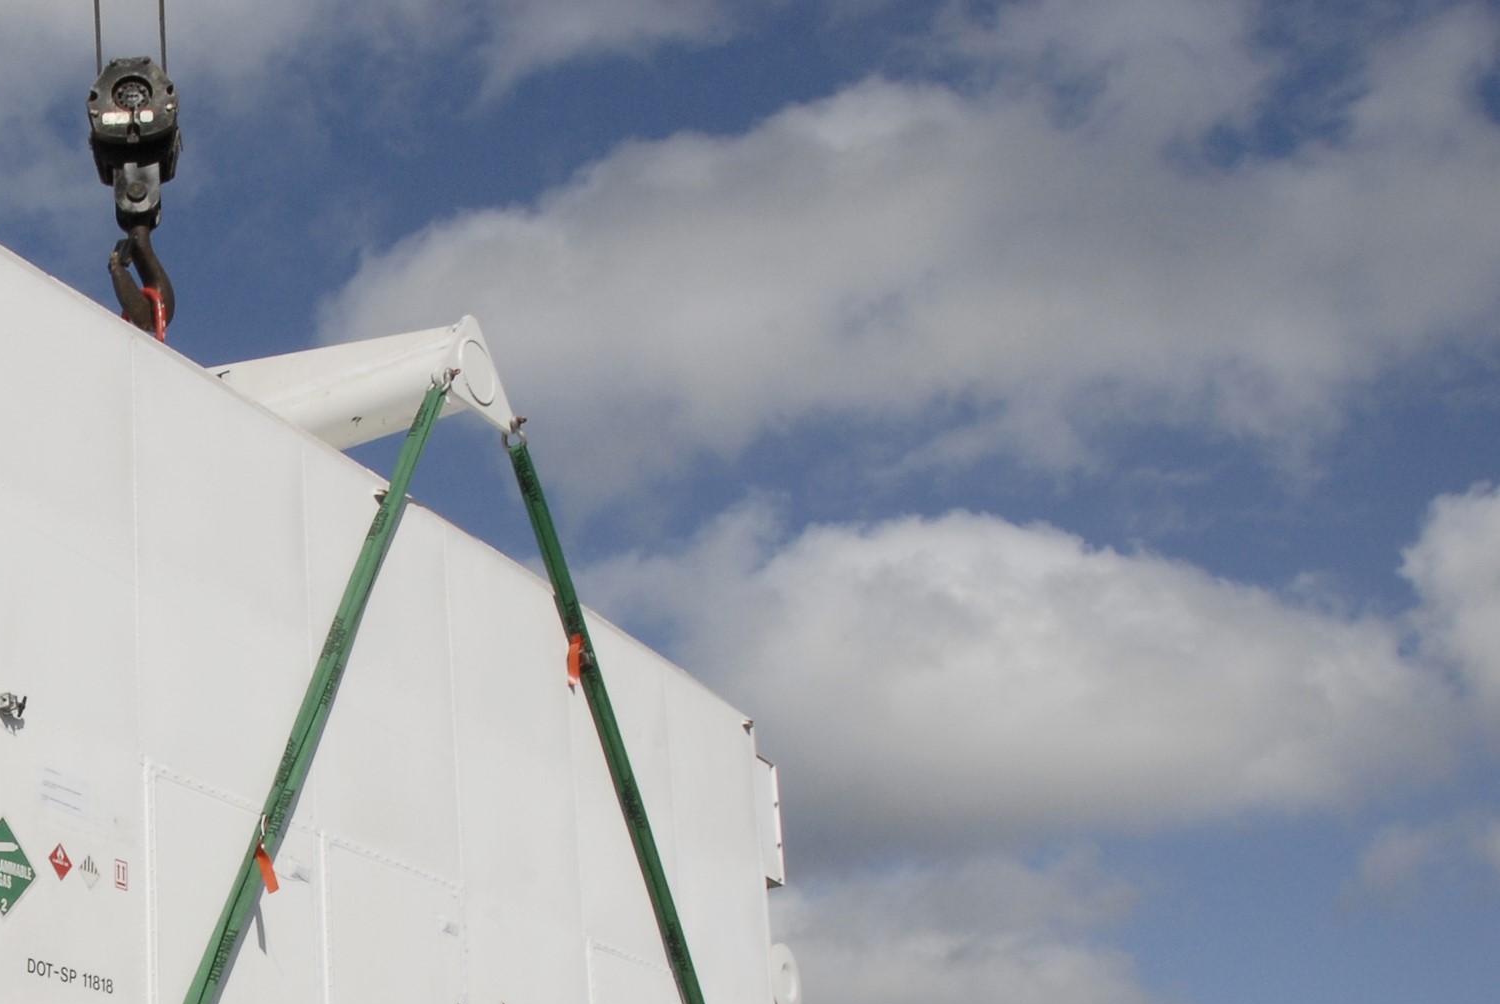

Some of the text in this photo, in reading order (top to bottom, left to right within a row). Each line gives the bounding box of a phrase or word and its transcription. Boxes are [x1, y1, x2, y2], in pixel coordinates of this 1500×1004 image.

[0, 898, 8, 912] 2
[27, 957, 114, 994] DOT-SP 11818
